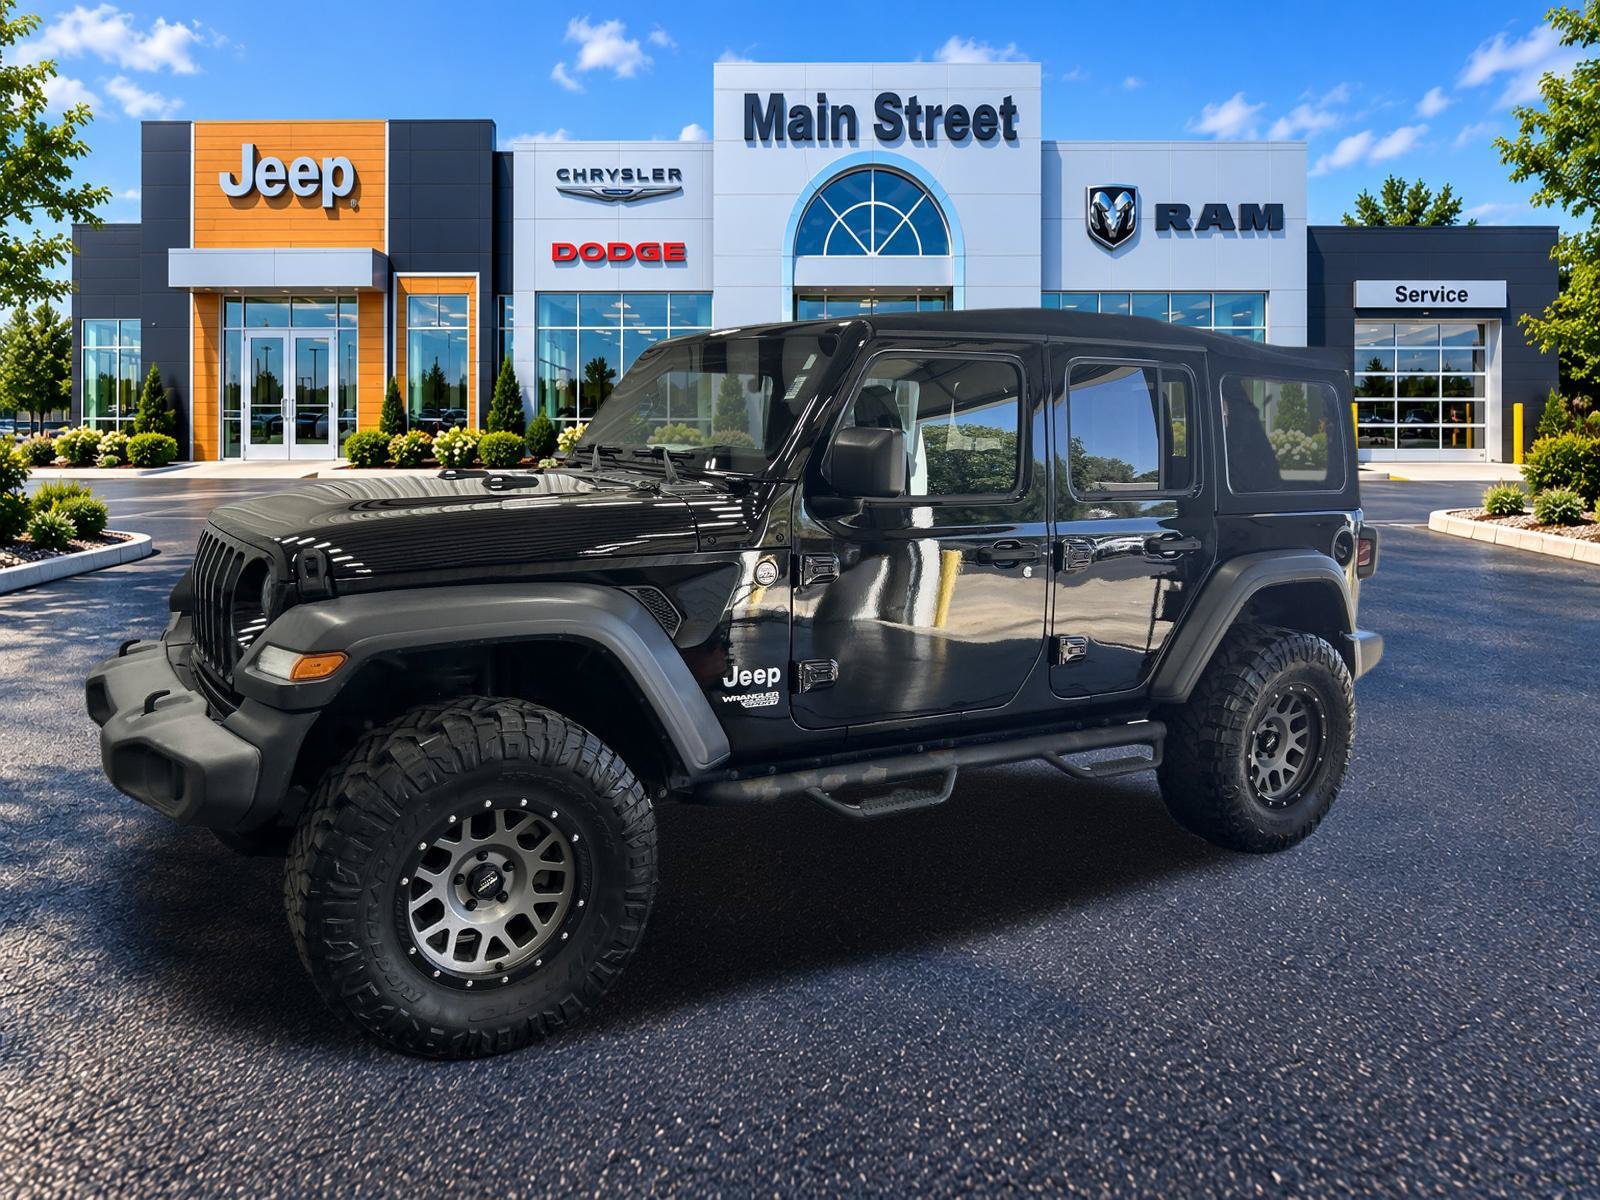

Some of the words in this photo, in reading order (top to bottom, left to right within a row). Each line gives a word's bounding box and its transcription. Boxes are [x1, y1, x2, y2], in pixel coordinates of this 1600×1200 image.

[744, 92, 857, 142] Main
[873, 91, 1018, 142] Street
[219, 143, 355, 208] Jeep
[556, 168, 683, 182] CHRYSLER
[1155, 203, 1284, 232] RAM
[552, 242, 687, 262] DODGE
[1395, 285, 1469, 303] Service
[722, 665, 781, 688] Jeep
[721, 691, 780, 703] WRANGLER
